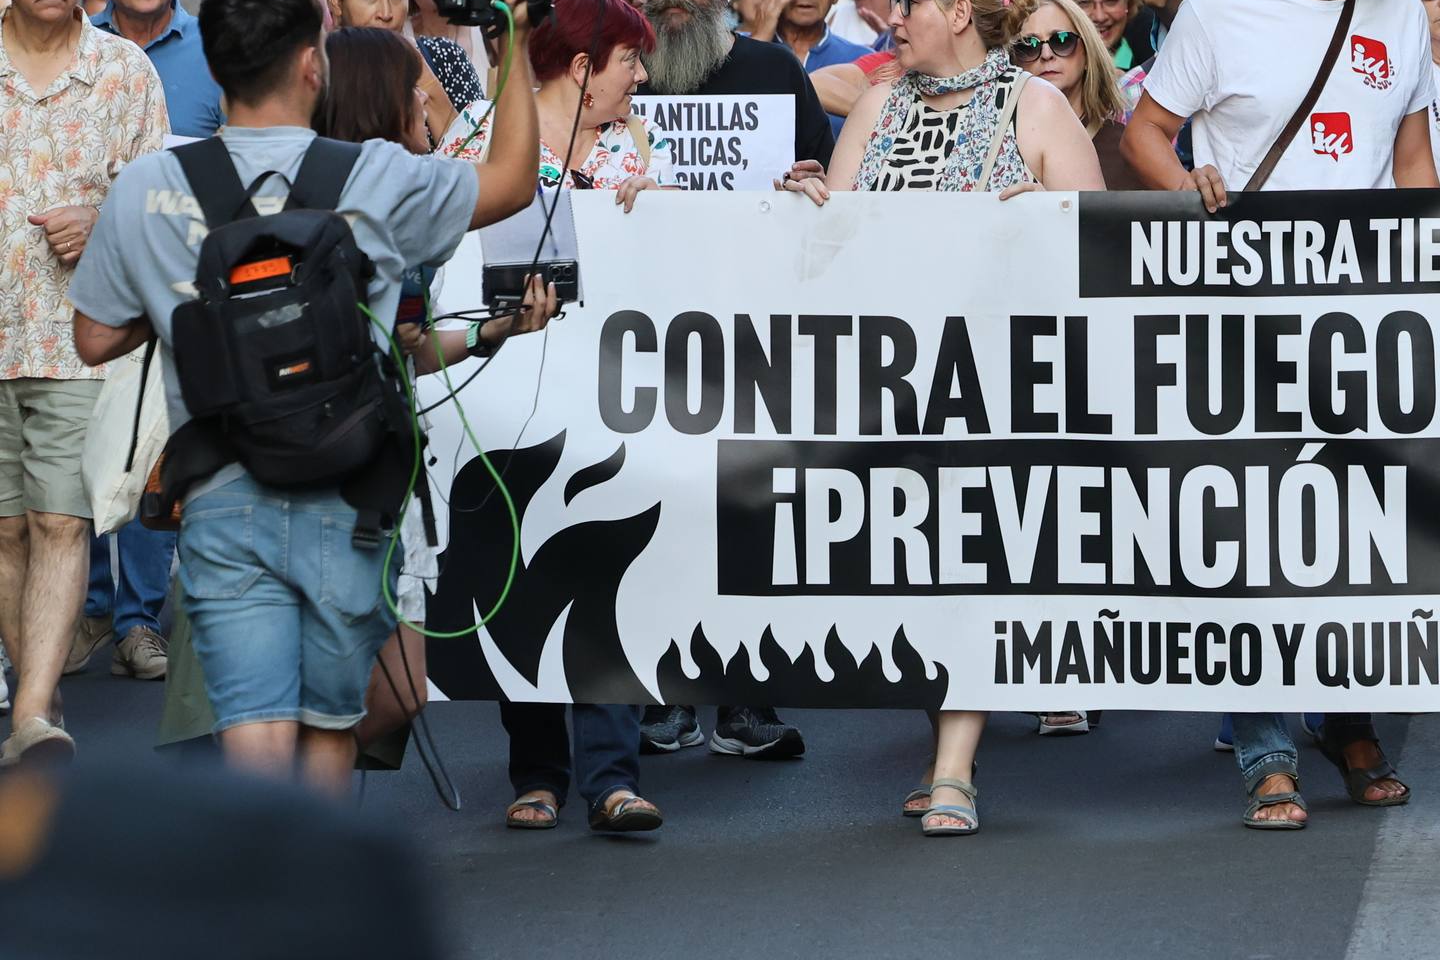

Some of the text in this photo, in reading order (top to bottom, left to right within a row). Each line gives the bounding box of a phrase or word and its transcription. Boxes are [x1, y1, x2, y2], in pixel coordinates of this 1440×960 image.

[1131, 220, 1367, 287] NUESTRA
[598, 310, 991, 436] CONTRA
[1009, 314, 1113, 434] EL
[1133, 310, 1437, 436] FUEGO
[771, 442, 1409, 589] ¡PREVENCIÓN
[993, 608, 1264, 687] ¡MAÑUECO
[1272, 622, 1306, 685] Y
